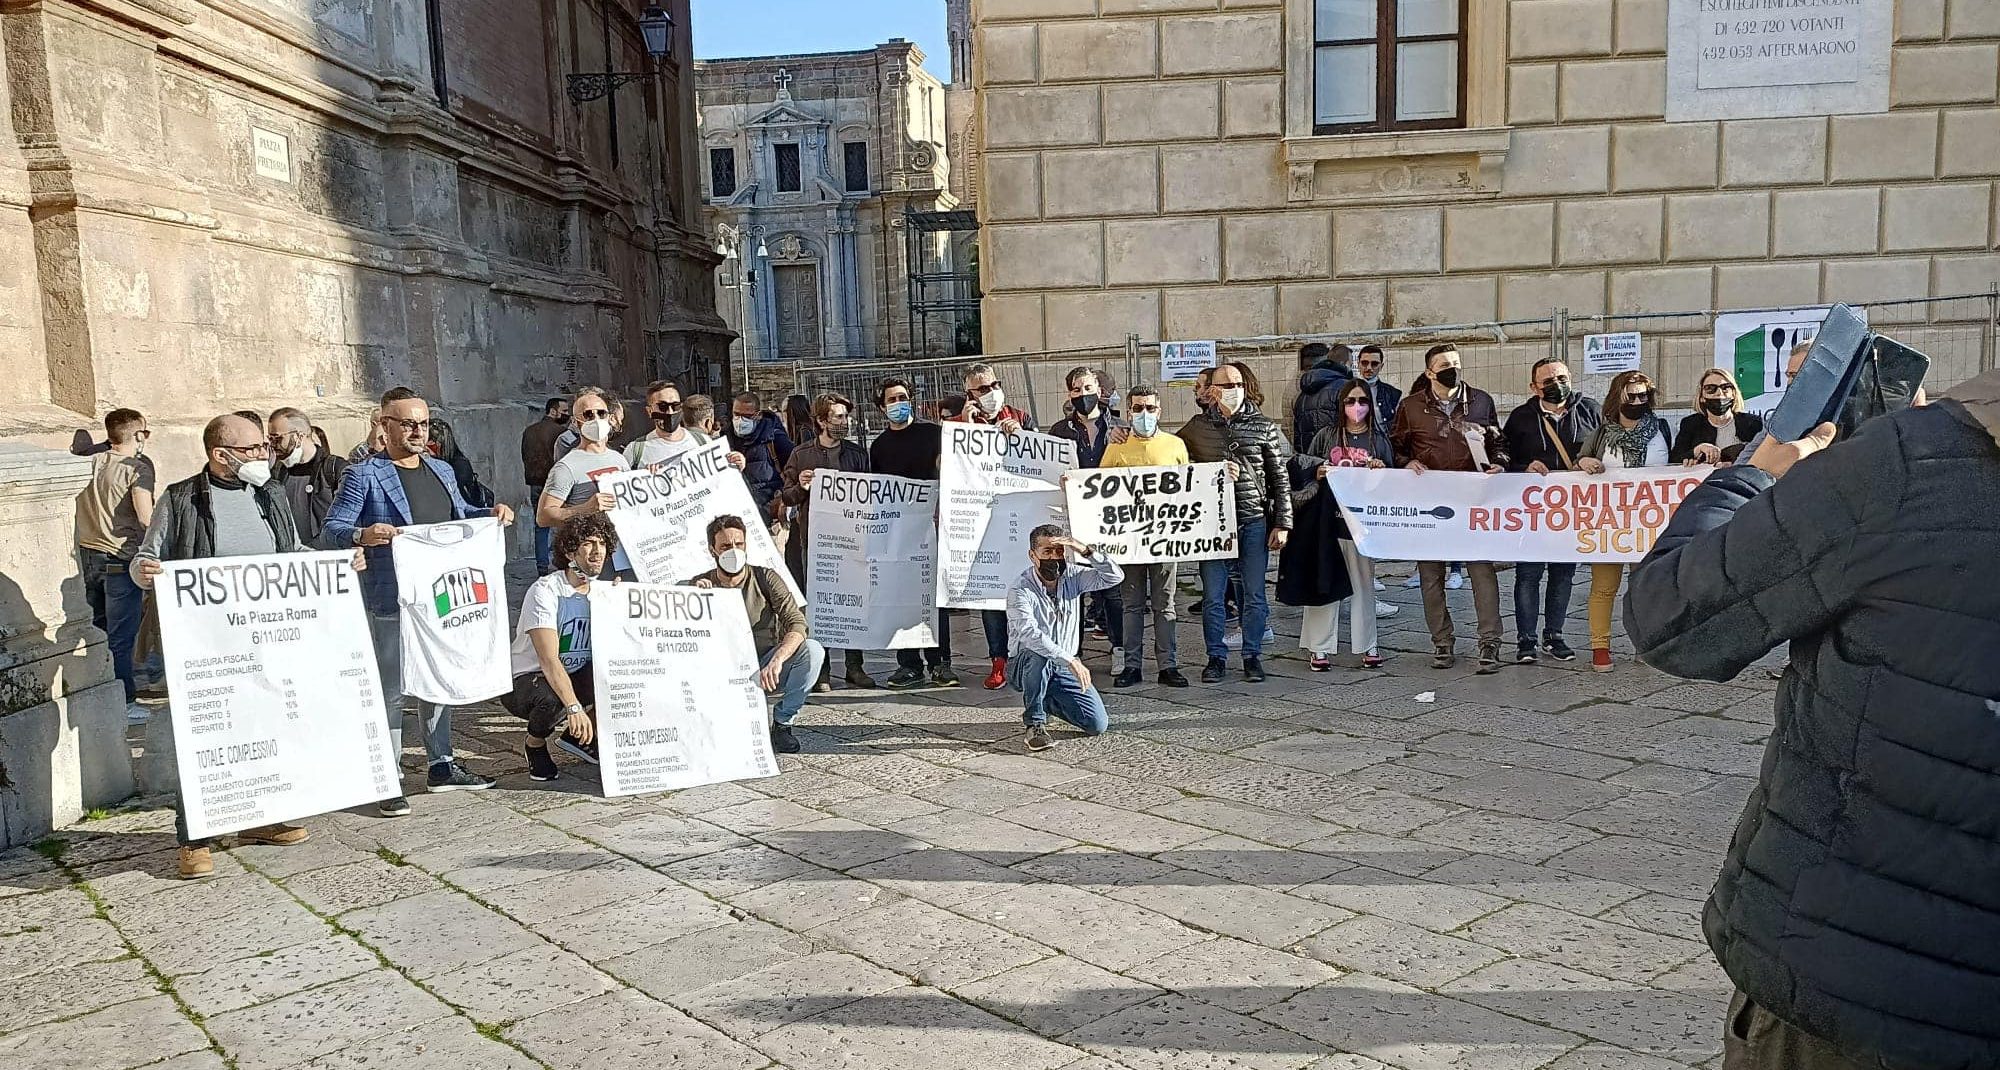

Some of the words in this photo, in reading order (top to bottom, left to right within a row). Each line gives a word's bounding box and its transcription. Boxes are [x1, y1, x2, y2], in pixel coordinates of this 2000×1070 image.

[1715, 22, 1727, 35] DI
[1791, 17, 1844, 32] VOTANTI
[1757, 41, 1856, 58] AFFERMARONO
[1609, 342, 1636, 350] ITALIANA
[953, 428, 1070, 464] RISTORANTE
[981, 462, 993, 472] Via
[996, 463, 1018, 474] Pazza
[1020, 465, 1042, 476] Roma
[613, 445, 728, 510] RISTORANTE
[821, 475, 931, 504] RISTORANTE
[1523, 478, 1700, 510] COMITATO
[650, 507, 665, 518] Via
[666, 498, 688, 513] Piazza
[689, 487, 711, 505] Roma
[1134, 490, 1146, 505] &
[843, 509, 854, 519] Via
[857, 510, 879, 520] Piazza
[881, 510, 900, 519] Roma
[1367, 505, 1418, 517] CO.RI.SICILIA
[855, 524, 888, 534] 6/11/2020
[1100, 525, 1126, 536] DAL
[175, 559, 349, 608] RISTORANTE
[628, 588, 714, 621] BISTROT
[227, 612, 247, 626] Via
[249, 610, 284, 624] Piazza
[286, 608, 317, 621] Roma
[252, 627, 301, 645] 6/11/2020
[640, 627, 653, 637] Via
[655, 628, 683, 638] Piazza
[685, 628, 711, 638] Roma
[657, 643, 698, 653] 6/11/2020
[184, 657, 222, 669] CHIUSURA
[224, 653, 255, 664] FISCALE
[216, 665, 263, 677] GIORNALIERO
[188, 686, 235, 699] DESCRIZIONE
[189, 700, 221, 711] REPARTO
[190, 712, 222, 723] REPARTO
[192, 723, 224, 734] REPARTO
[614, 731, 636, 748] TOTALE
[638, 727, 678, 746] COMPLESSIVO
[196, 748, 224, 769] TOTALE
[228, 739, 278, 764] COMPLESSIVO
[201, 781, 243, 795] PAGAMENTO
[245, 774, 280, 787] CONTANTE
[246, 783, 292, 798] ELETTRONICO
